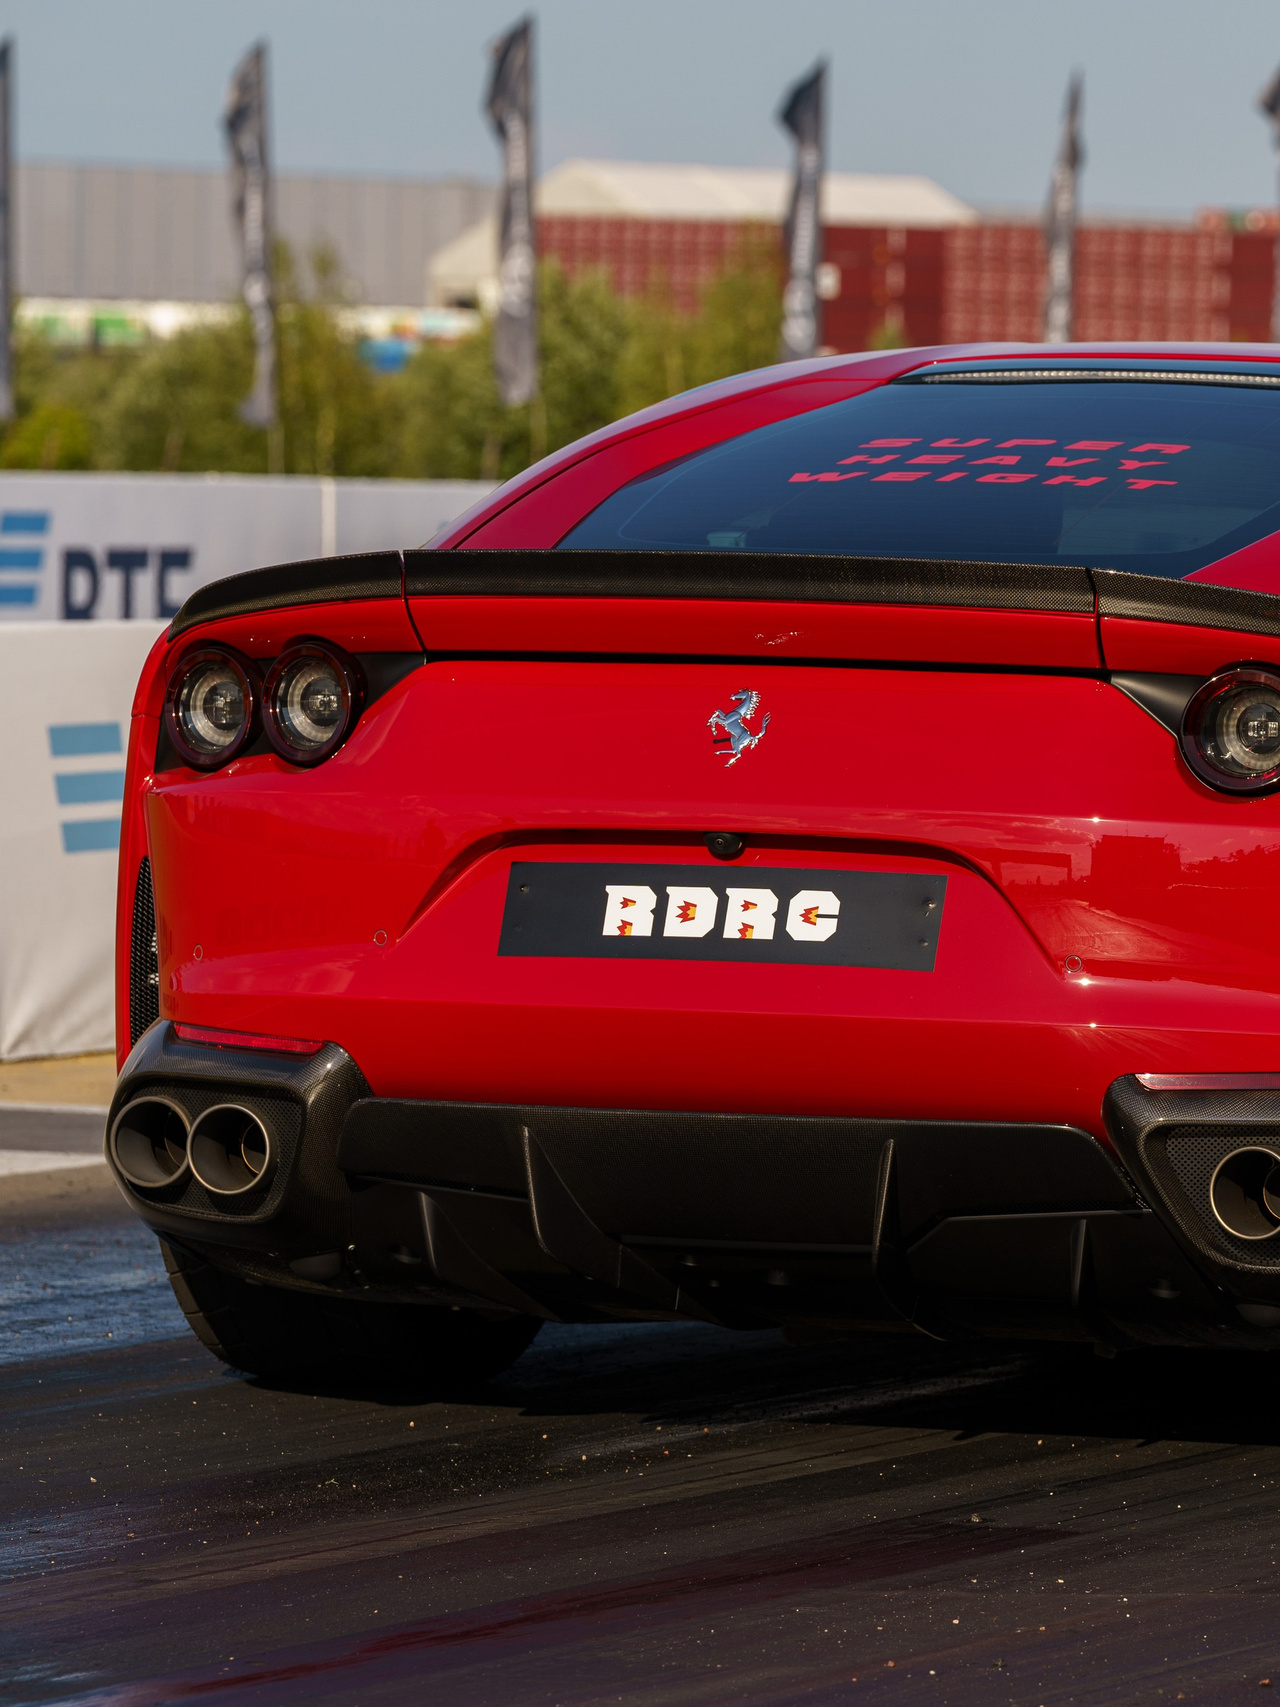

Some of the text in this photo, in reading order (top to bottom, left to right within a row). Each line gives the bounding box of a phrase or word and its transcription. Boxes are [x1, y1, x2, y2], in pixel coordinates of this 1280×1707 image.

[858, 438, 1191, 454] SUPER
[836, 454, 1171, 470] HEAVY
[788, 471, 1179, 490] WEIGHT
[602, 885, 841, 942] RDRC
